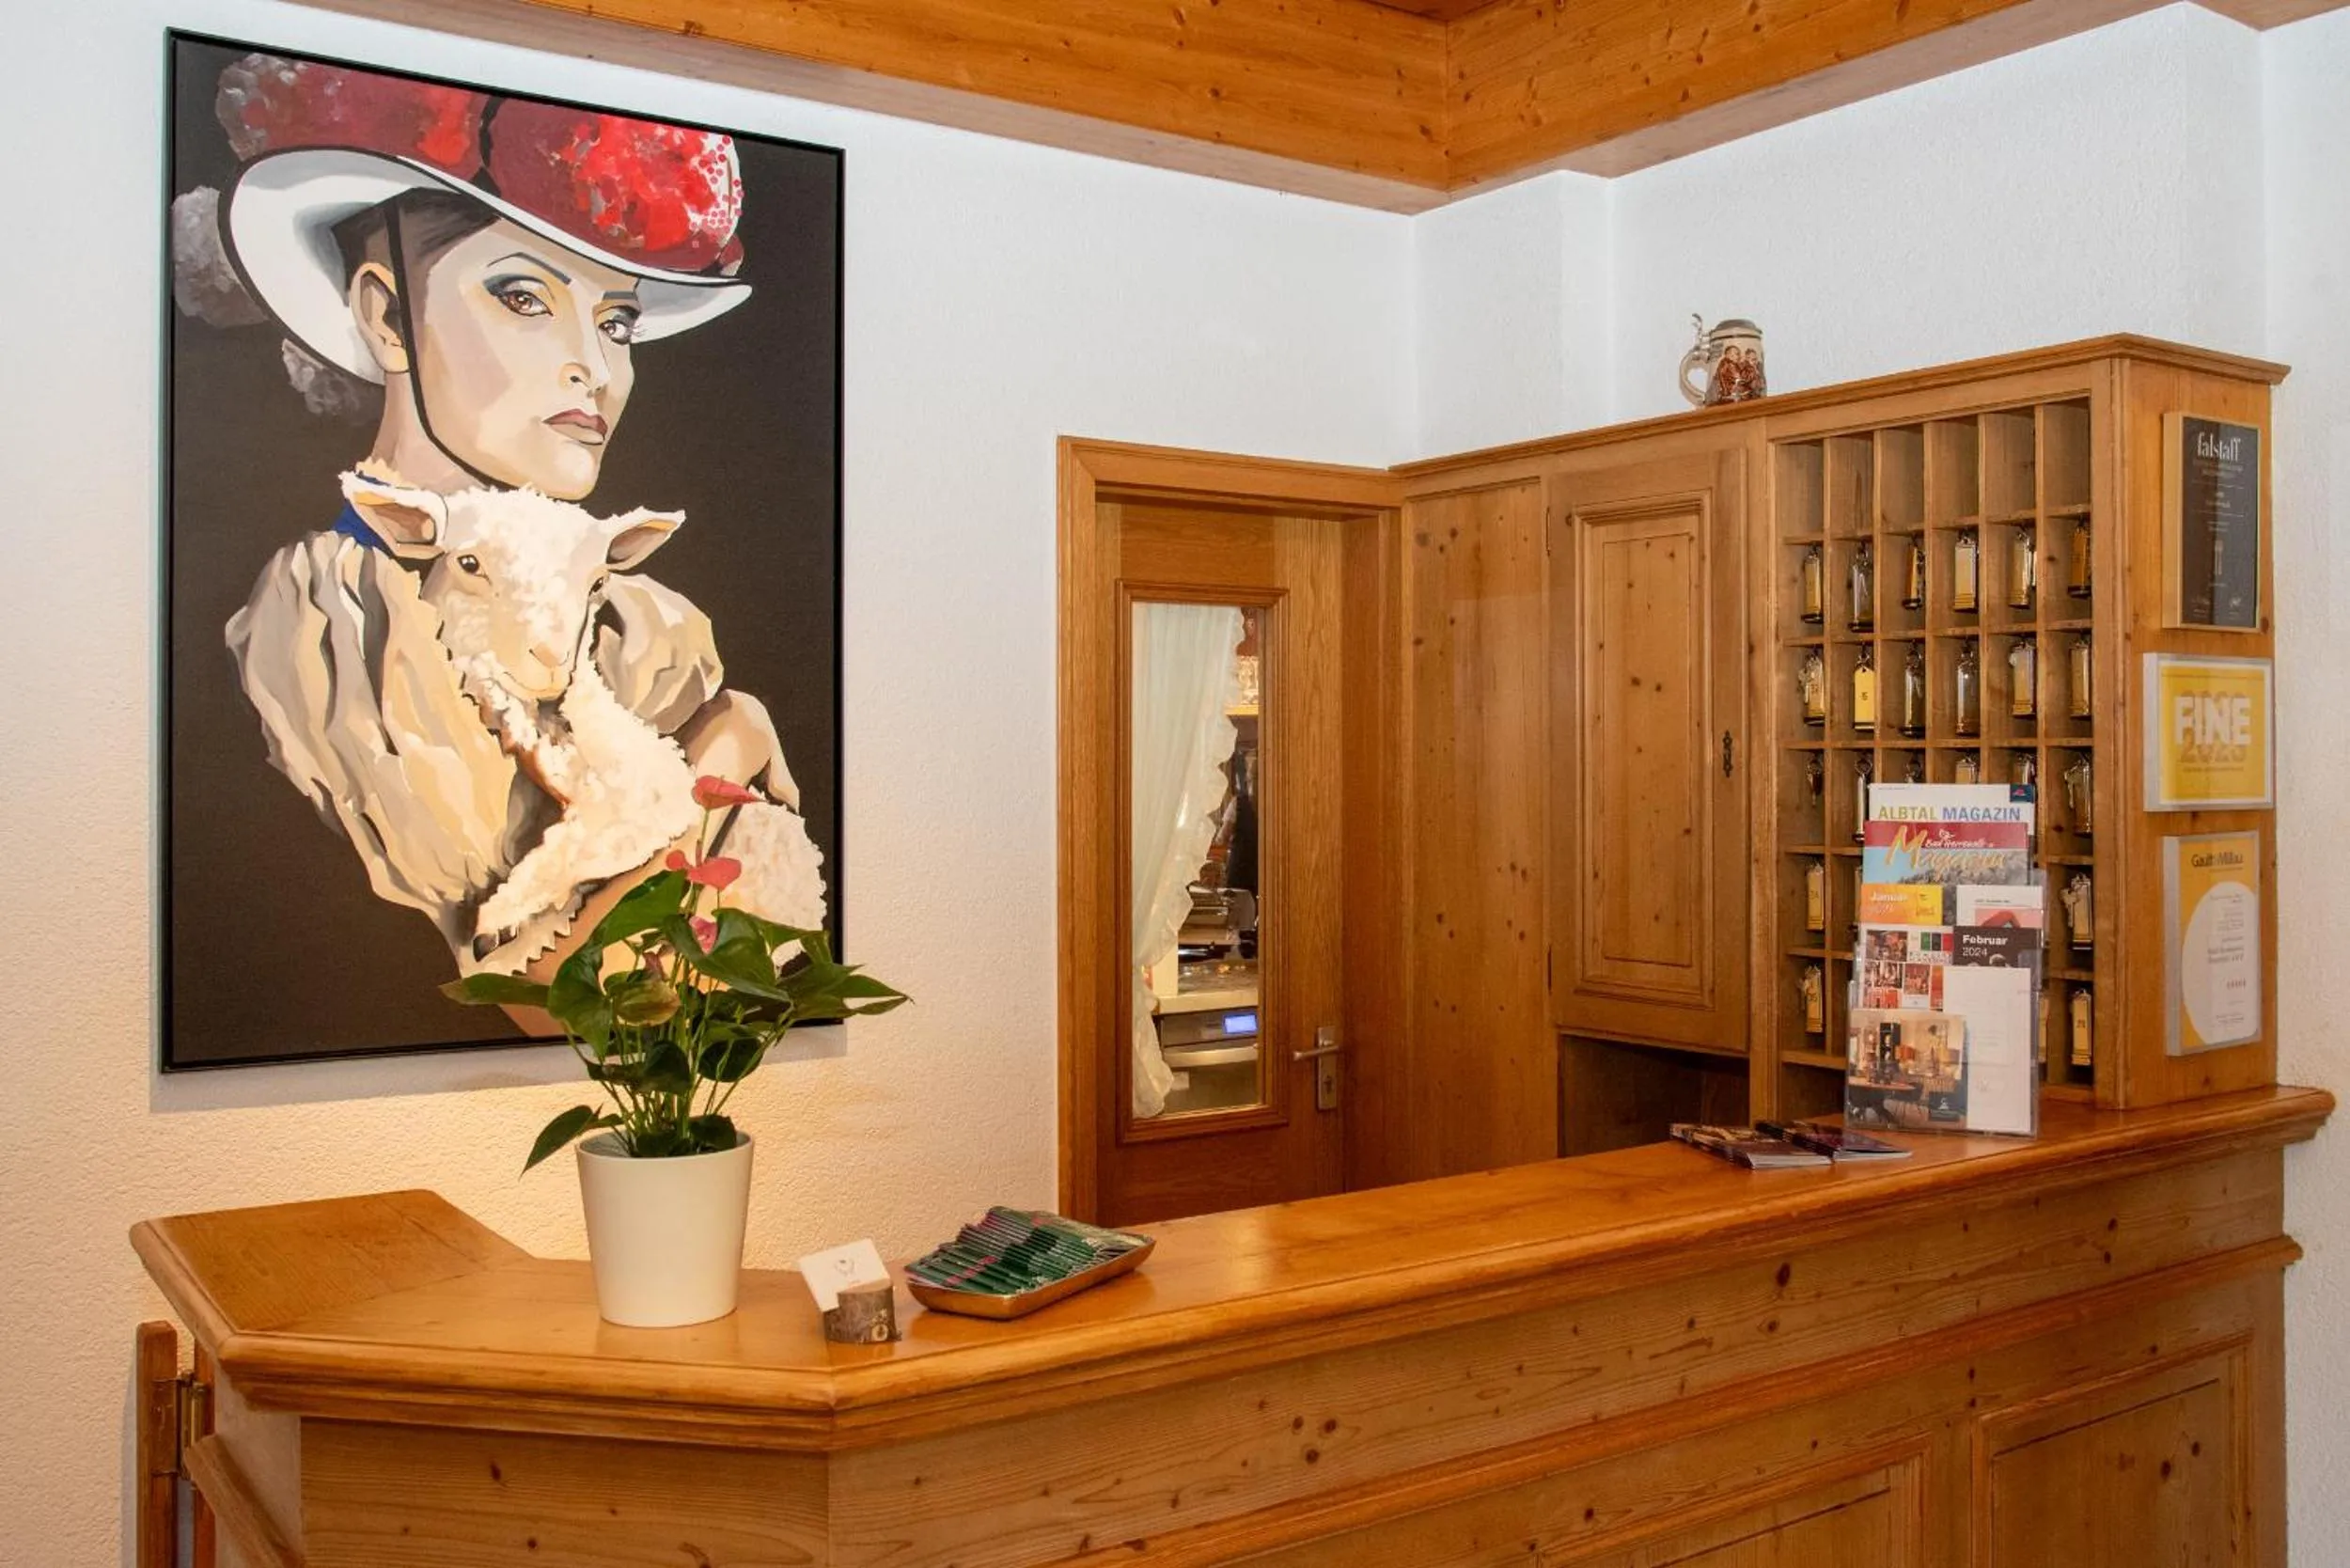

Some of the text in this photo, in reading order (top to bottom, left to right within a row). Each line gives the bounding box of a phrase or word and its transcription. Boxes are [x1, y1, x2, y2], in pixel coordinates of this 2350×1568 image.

[2196, 431, 2241, 462] falstaff
[2174, 696, 2251, 745] FINE
[1879, 806, 2021, 821] ALBTAL MAGAZIN
[1962, 934, 2009, 946] Februar
[1962, 947, 1988, 957] 2024
